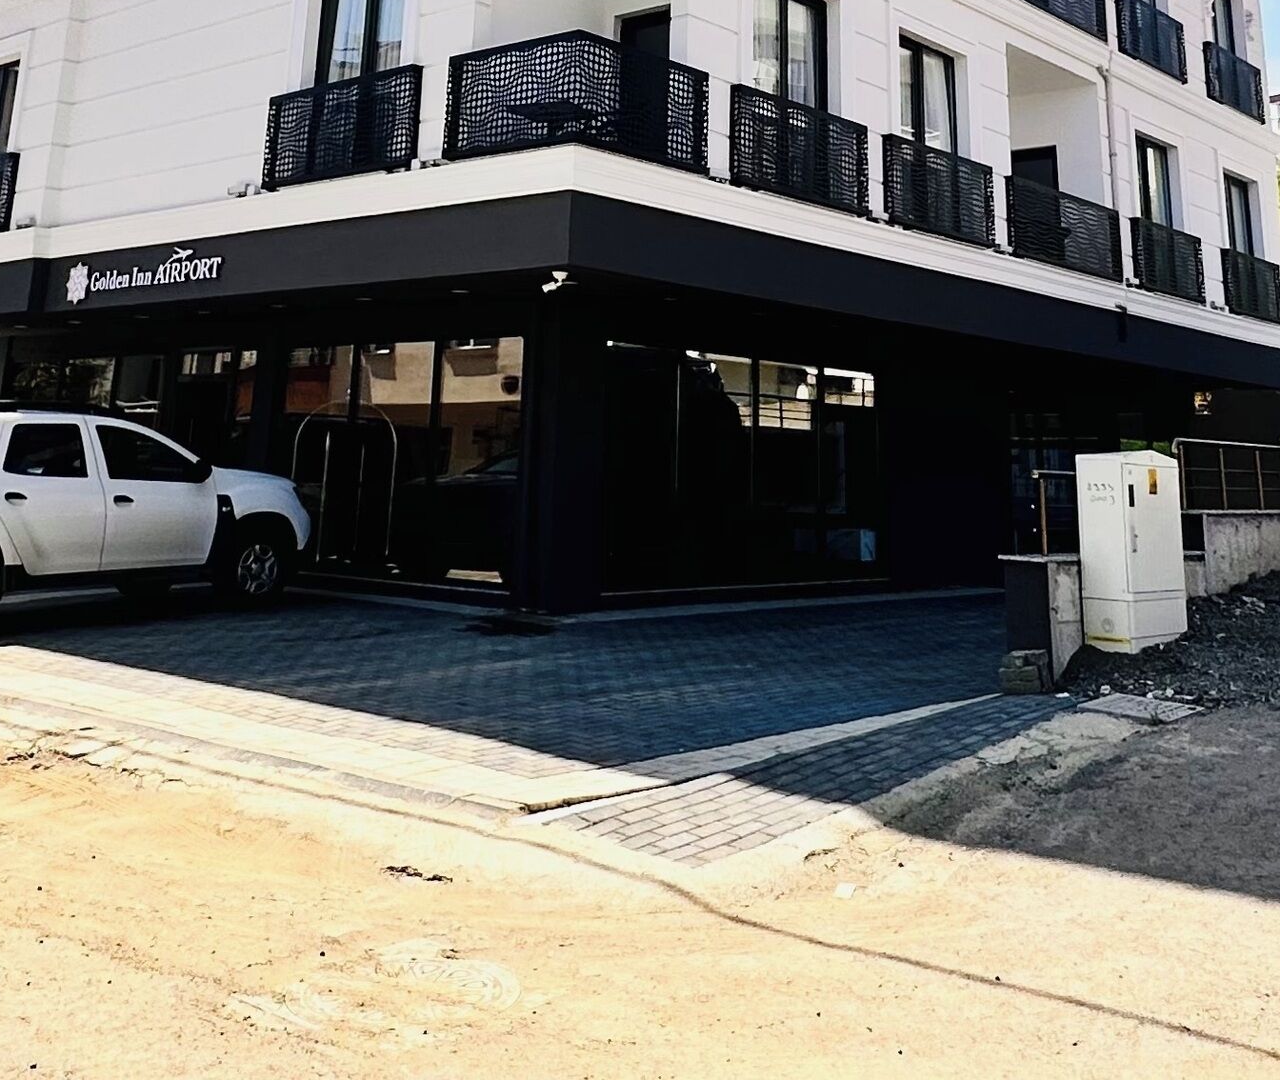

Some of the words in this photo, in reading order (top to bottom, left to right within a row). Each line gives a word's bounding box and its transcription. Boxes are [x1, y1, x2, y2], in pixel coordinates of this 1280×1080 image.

[90, 270, 130, 292] Golden
[131, 267, 152, 287] Inn
[153, 256, 222, 285] AIRPORT
